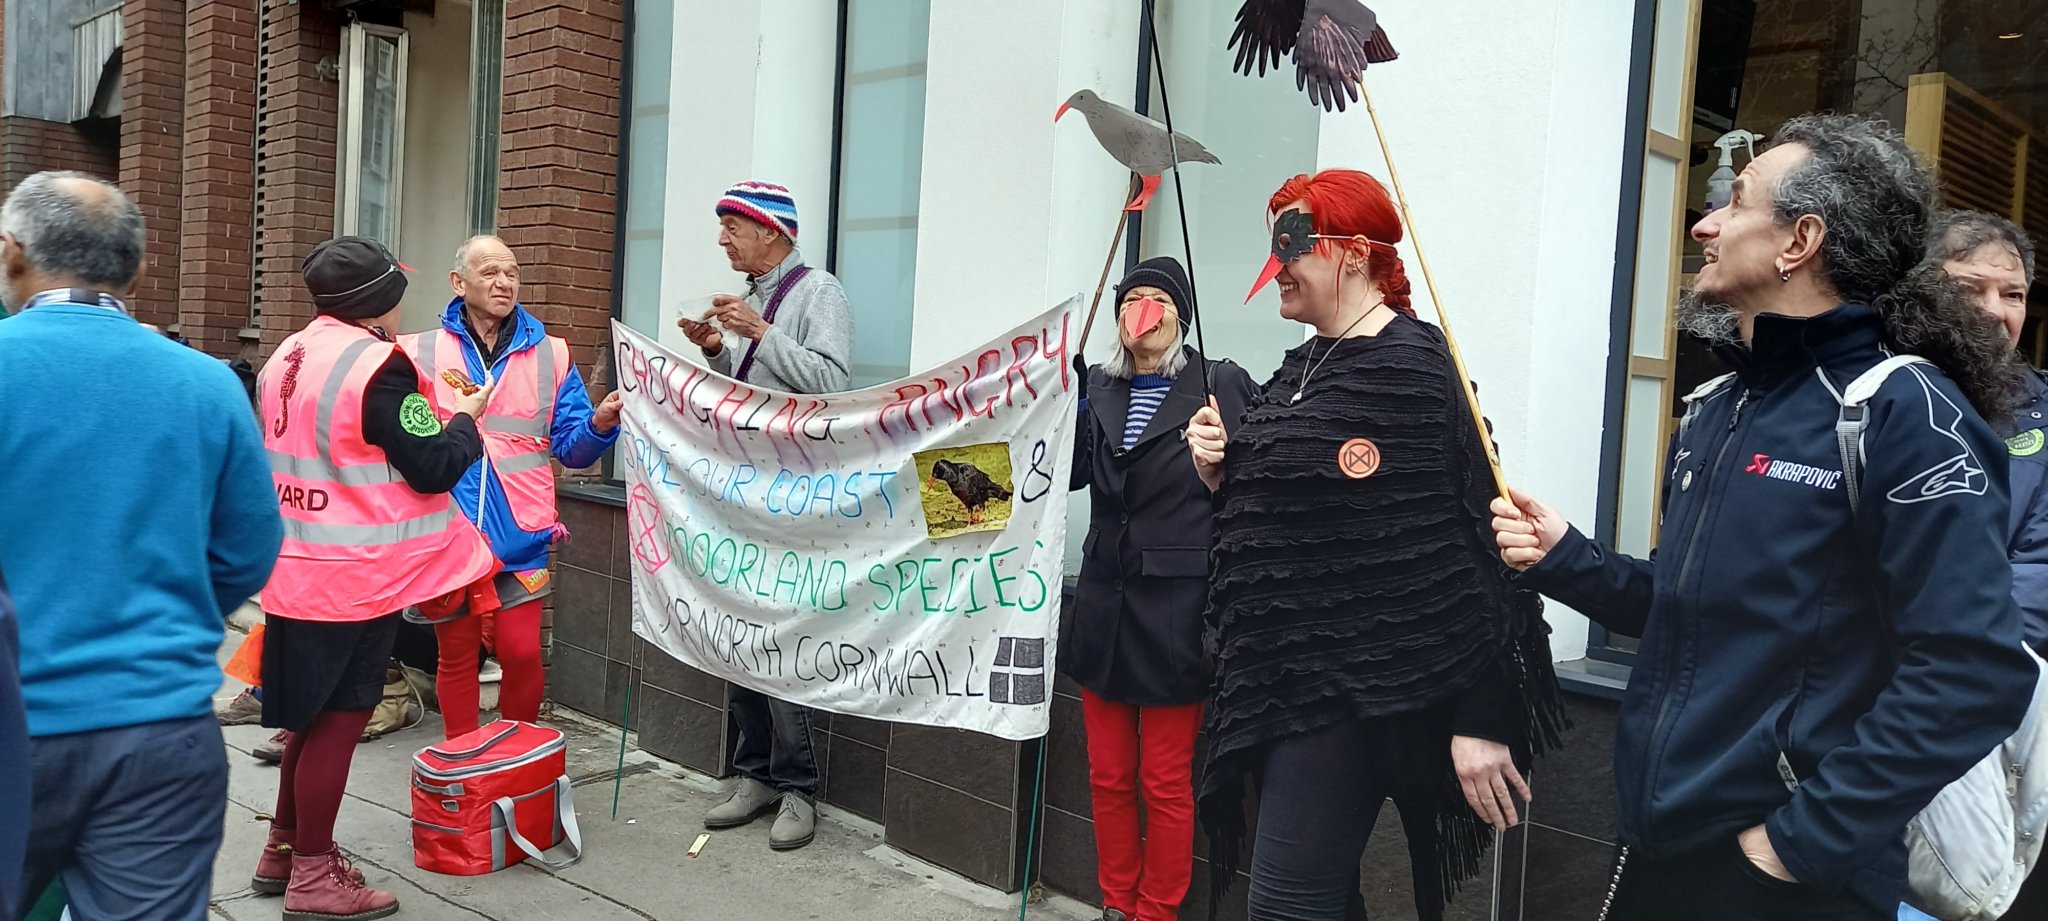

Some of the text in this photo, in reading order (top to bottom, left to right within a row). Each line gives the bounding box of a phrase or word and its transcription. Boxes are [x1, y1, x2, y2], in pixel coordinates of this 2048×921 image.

[618, 312, 1071, 445] CHOUGHING ANGRY
[624, 430, 1055, 519] SAVE OUR COAST &
[665, 521, 1047, 614] MOORLAND SPECIES
[697, 608, 782, 678] NORTH
[794, 634, 987, 698] CORNWALL
